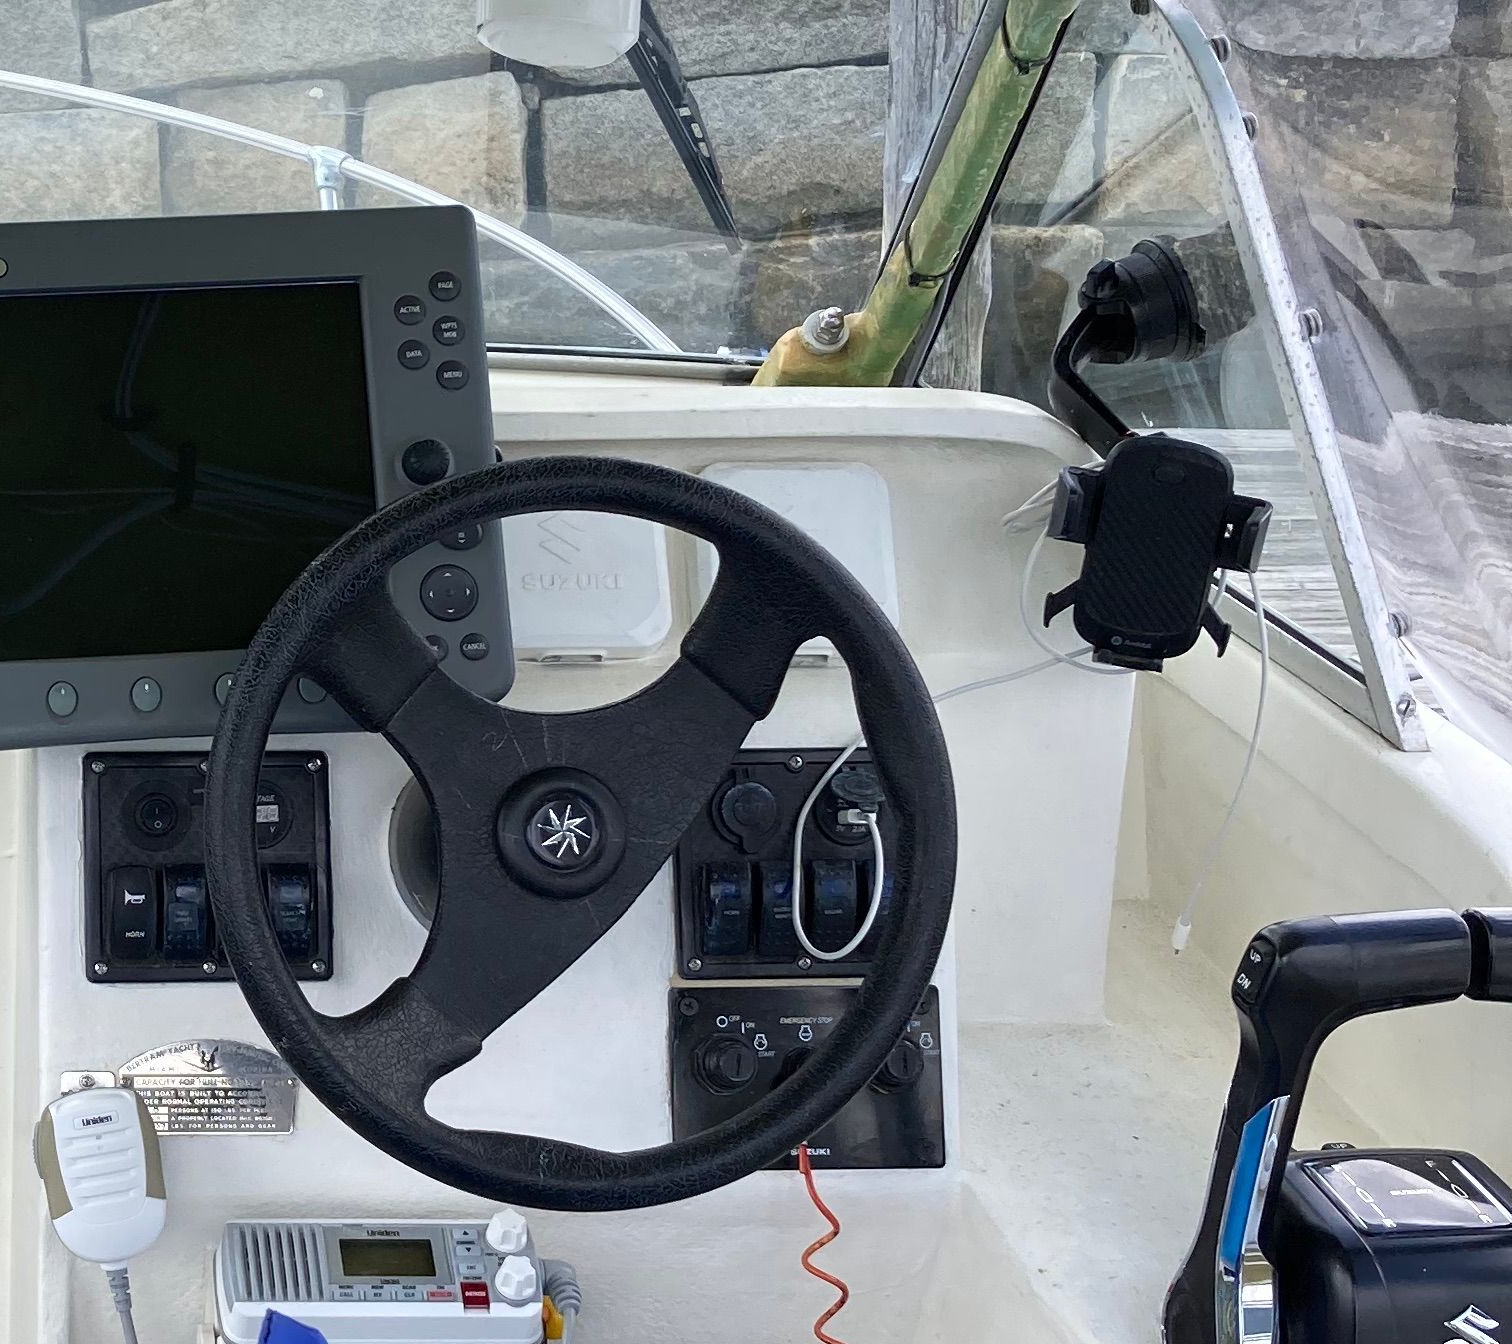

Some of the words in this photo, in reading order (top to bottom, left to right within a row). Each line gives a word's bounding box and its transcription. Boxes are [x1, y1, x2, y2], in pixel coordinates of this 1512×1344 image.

[437, 281, 454, 289] PAGE
[399, 305, 420, 314] ACTIVE
[405, 349, 423, 358] DATA
[443, 371, 463, 379] MENU
[462, 642, 487, 651] CANCEL
[125, 930, 145, 938] HORN
[1249, 948, 1262, 963] UP
[1237, 972, 1252, 989] DN
[779, 1016, 816, 1024] EMERGENCY
[816, 1016, 834, 1024] STOP
[136, 1078, 176, 1086] CAPACITY
[81, 1115, 113, 1127] Uniden
[790, 1147, 831, 1156] SZUKI
[366, 1229, 400, 1237] Uniden
